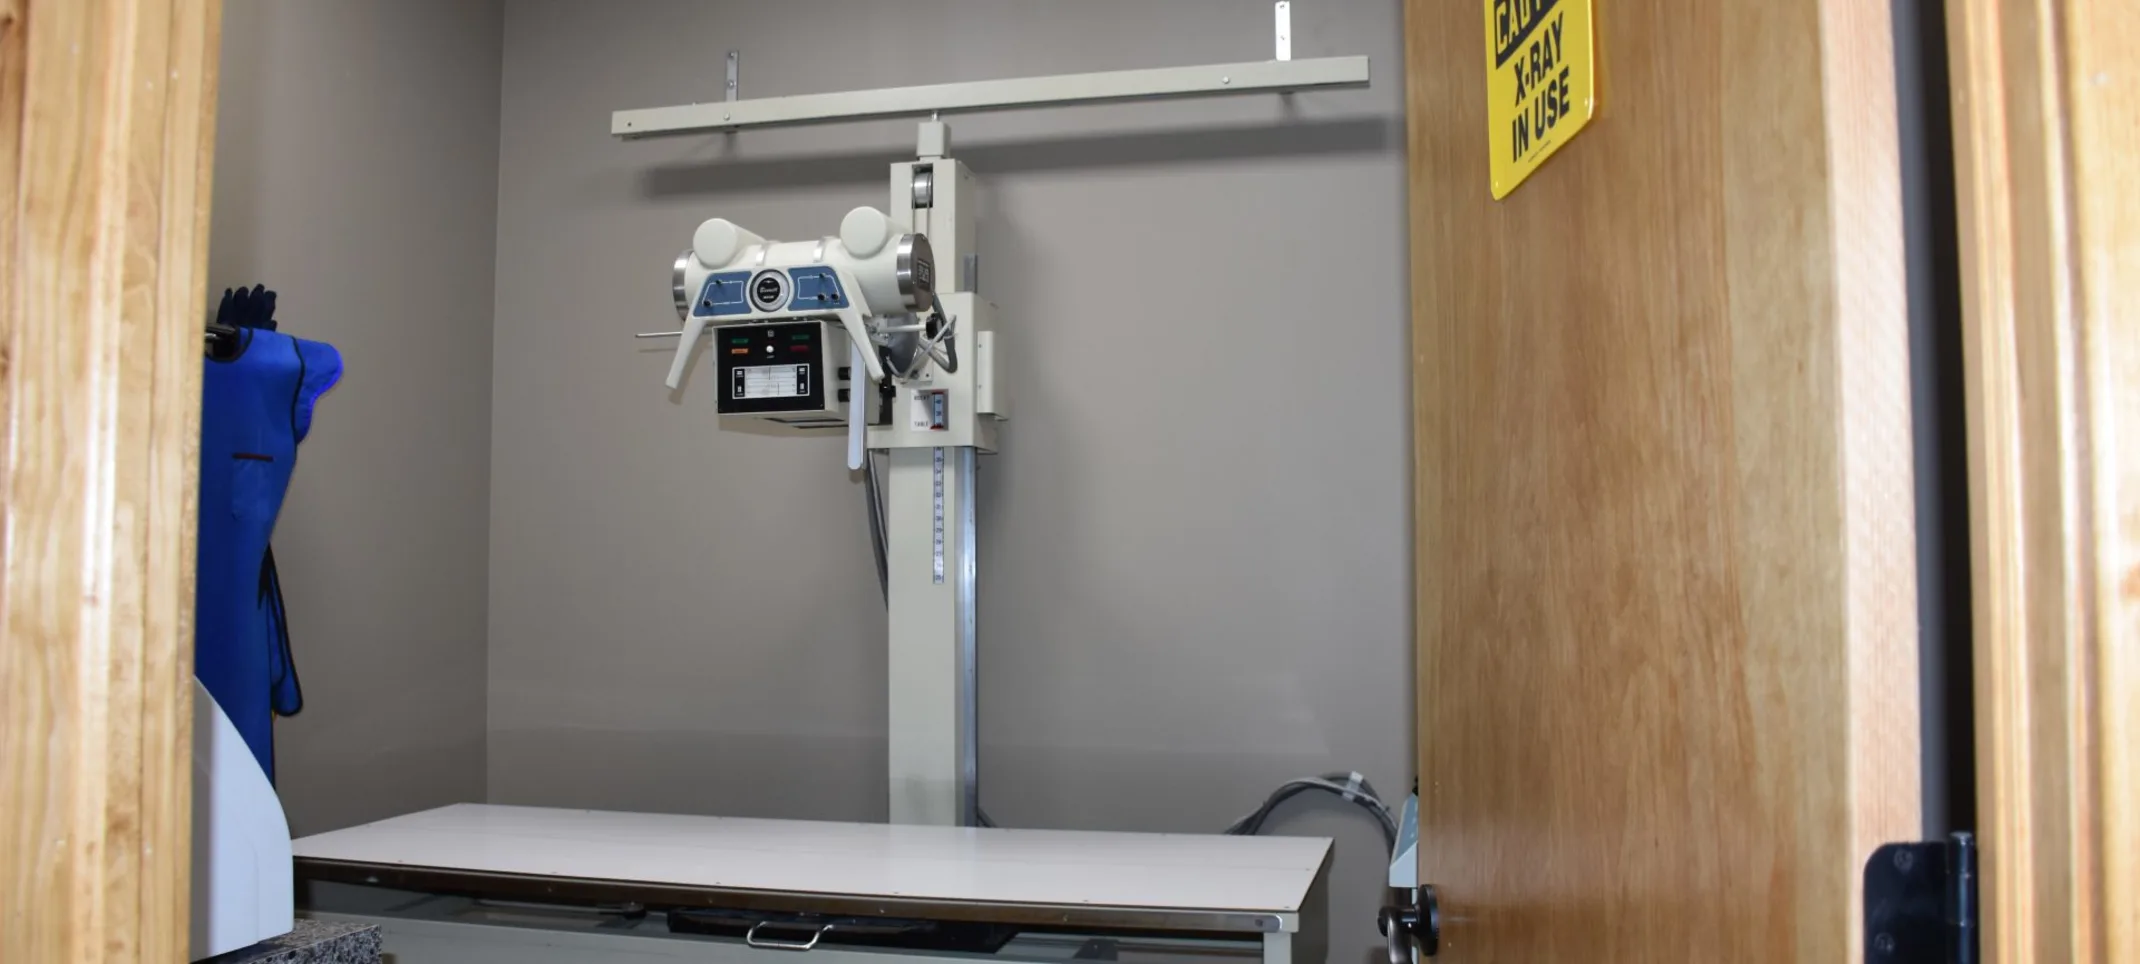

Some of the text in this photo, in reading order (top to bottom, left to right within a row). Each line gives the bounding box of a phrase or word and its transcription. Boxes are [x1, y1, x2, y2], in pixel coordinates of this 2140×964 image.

[1496, 0, 1541, 55] CAU
[1514, 10, 1564, 107] X-RAY
[1512, 107, 1529, 163] IN
[1534, 65, 1570, 141] USE
